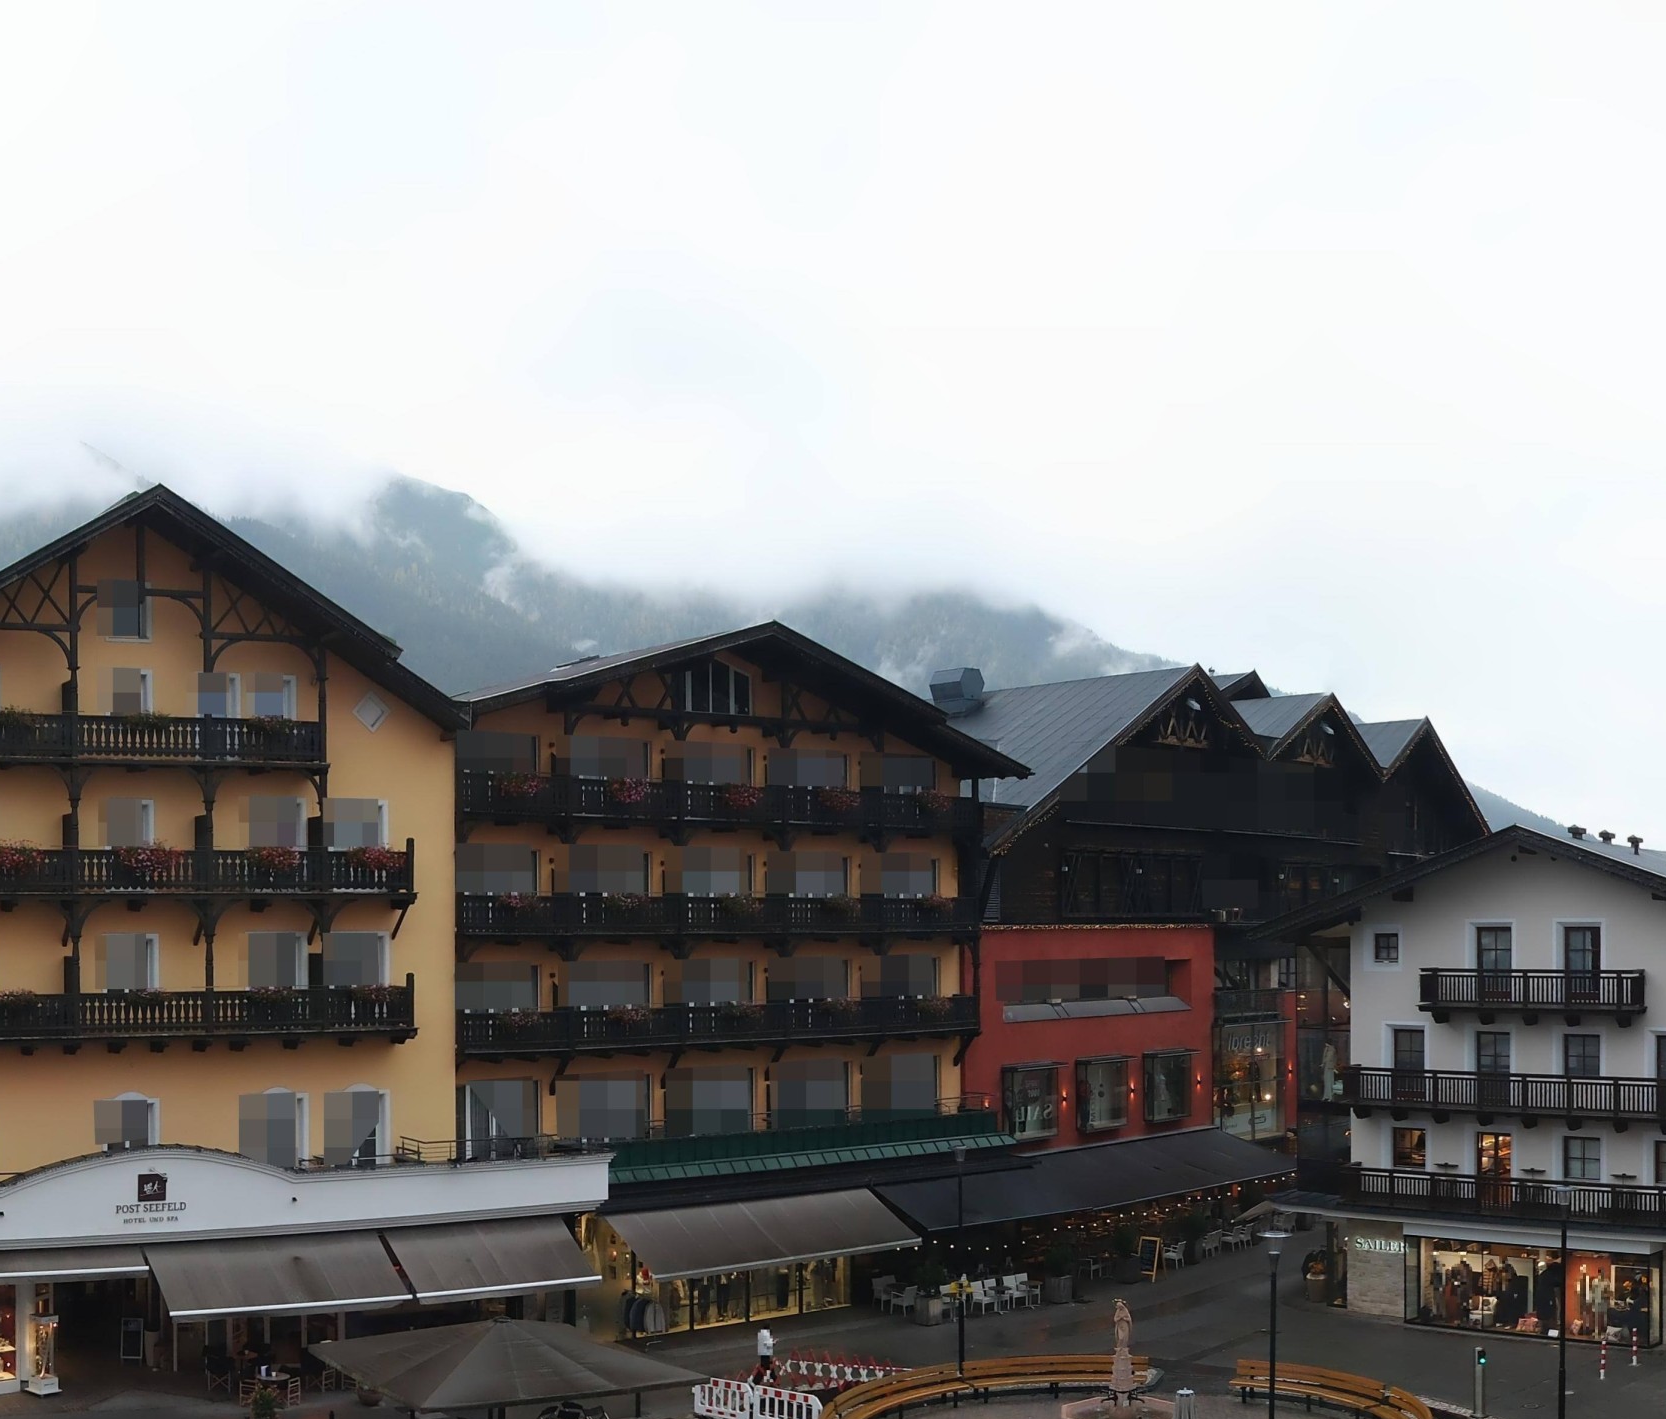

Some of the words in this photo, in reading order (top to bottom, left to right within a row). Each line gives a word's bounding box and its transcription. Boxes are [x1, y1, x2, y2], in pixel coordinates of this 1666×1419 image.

[116, 1204, 141, 1214] POST
[143, 1202, 187, 1213] SEEFELD
[1355, 1236, 1409, 1253] SAILER
